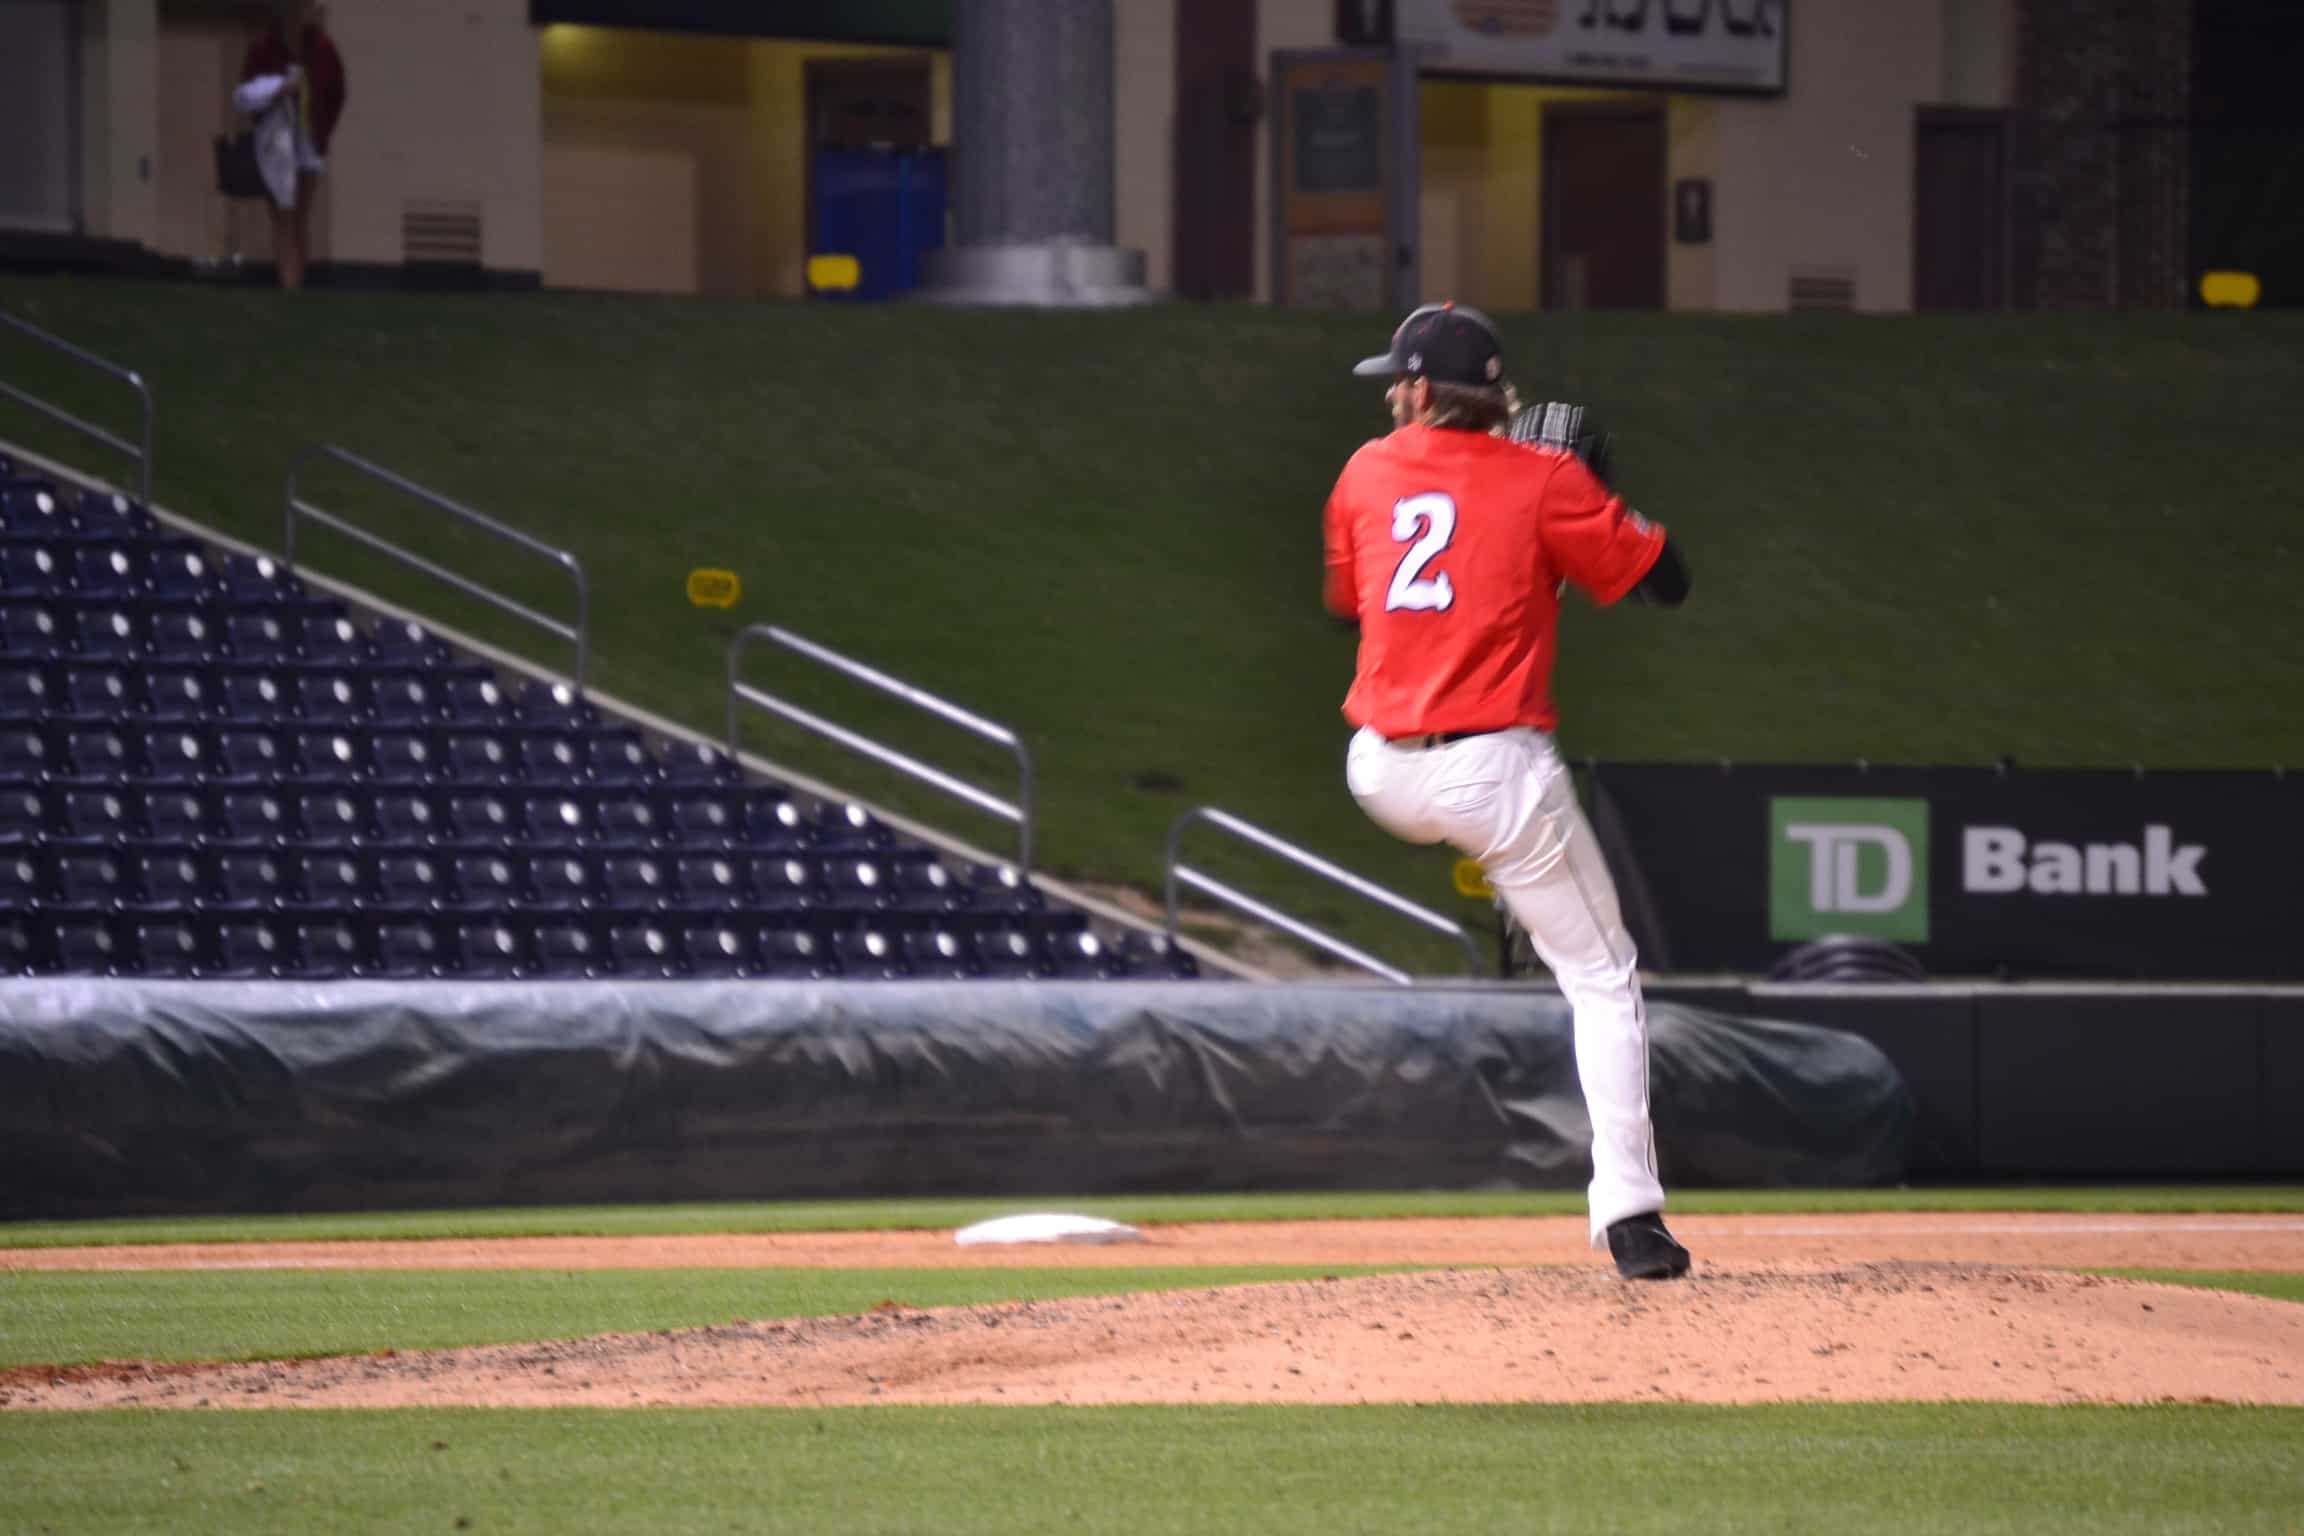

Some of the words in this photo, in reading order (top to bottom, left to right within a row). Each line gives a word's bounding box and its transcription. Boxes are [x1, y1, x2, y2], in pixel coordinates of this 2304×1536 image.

[1386, 492, 1456, 613] 2
[1785, 822, 1914, 912] TD
[1962, 825, 2208, 895] Bank
